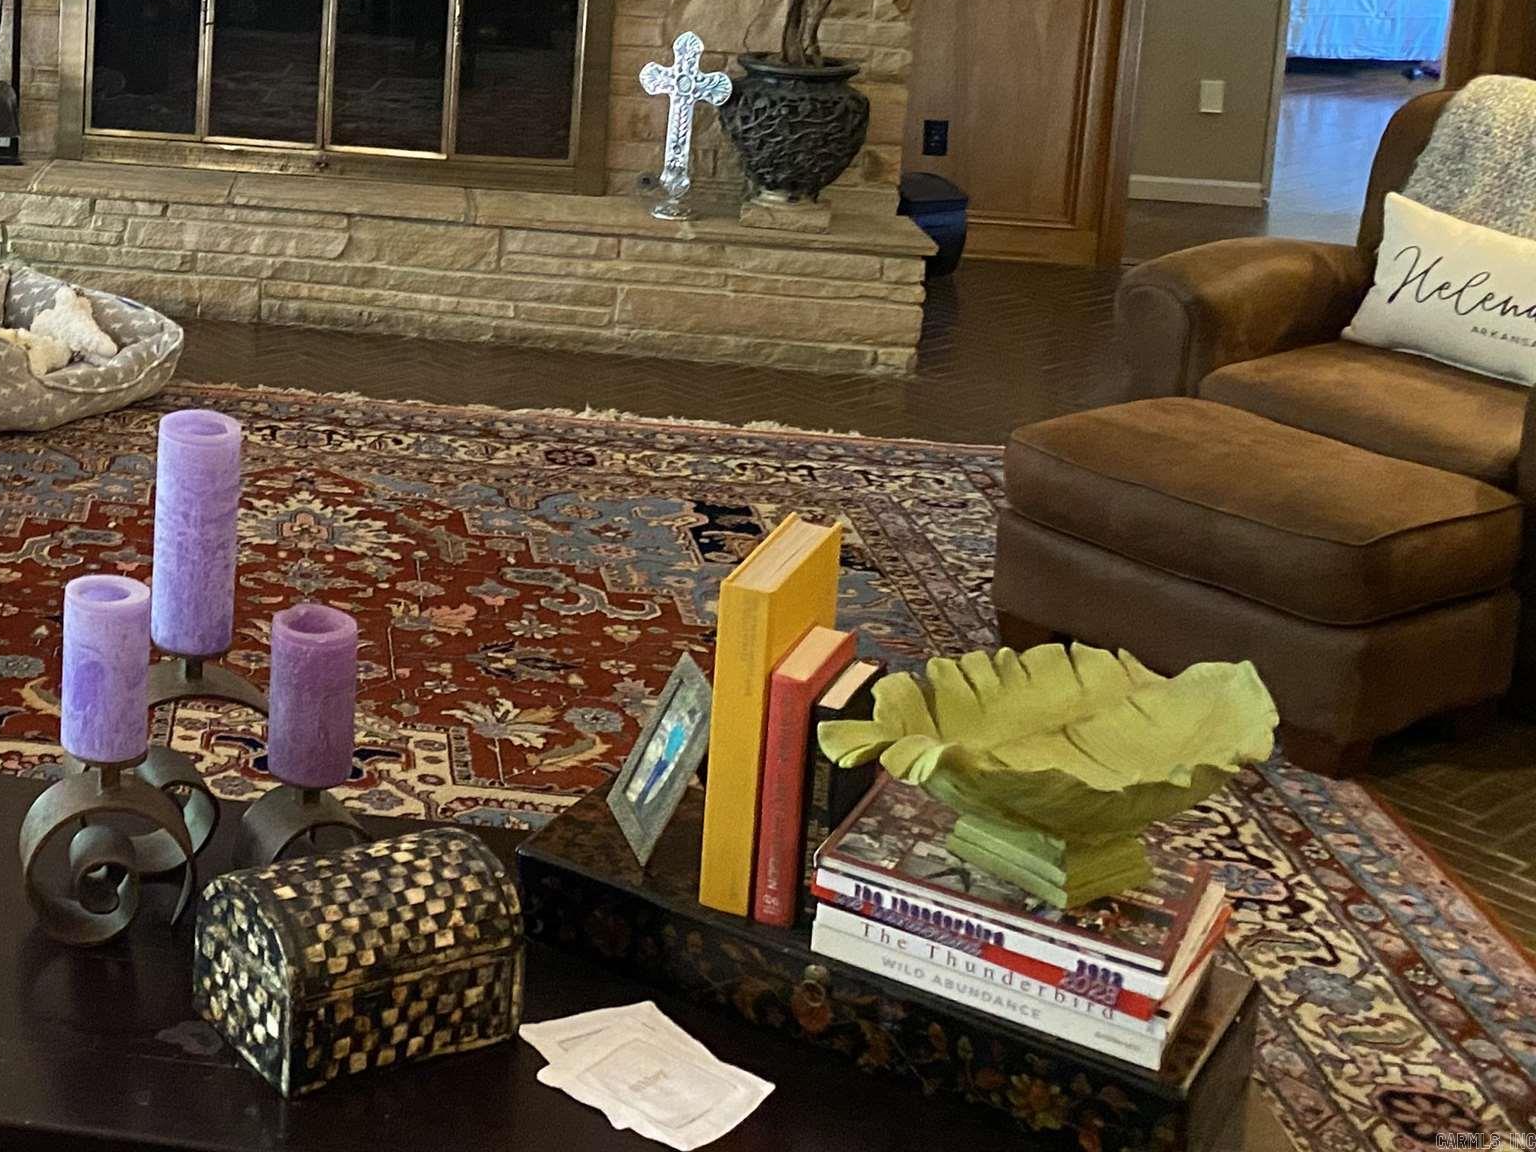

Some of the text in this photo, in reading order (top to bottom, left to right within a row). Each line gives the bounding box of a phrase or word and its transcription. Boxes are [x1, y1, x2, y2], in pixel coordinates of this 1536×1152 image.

[861, 921, 907, 949] The
[927, 942, 1115, 1021] Thunderbird
[880, 955, 1042, 1019] WILD ABUNDANCE
